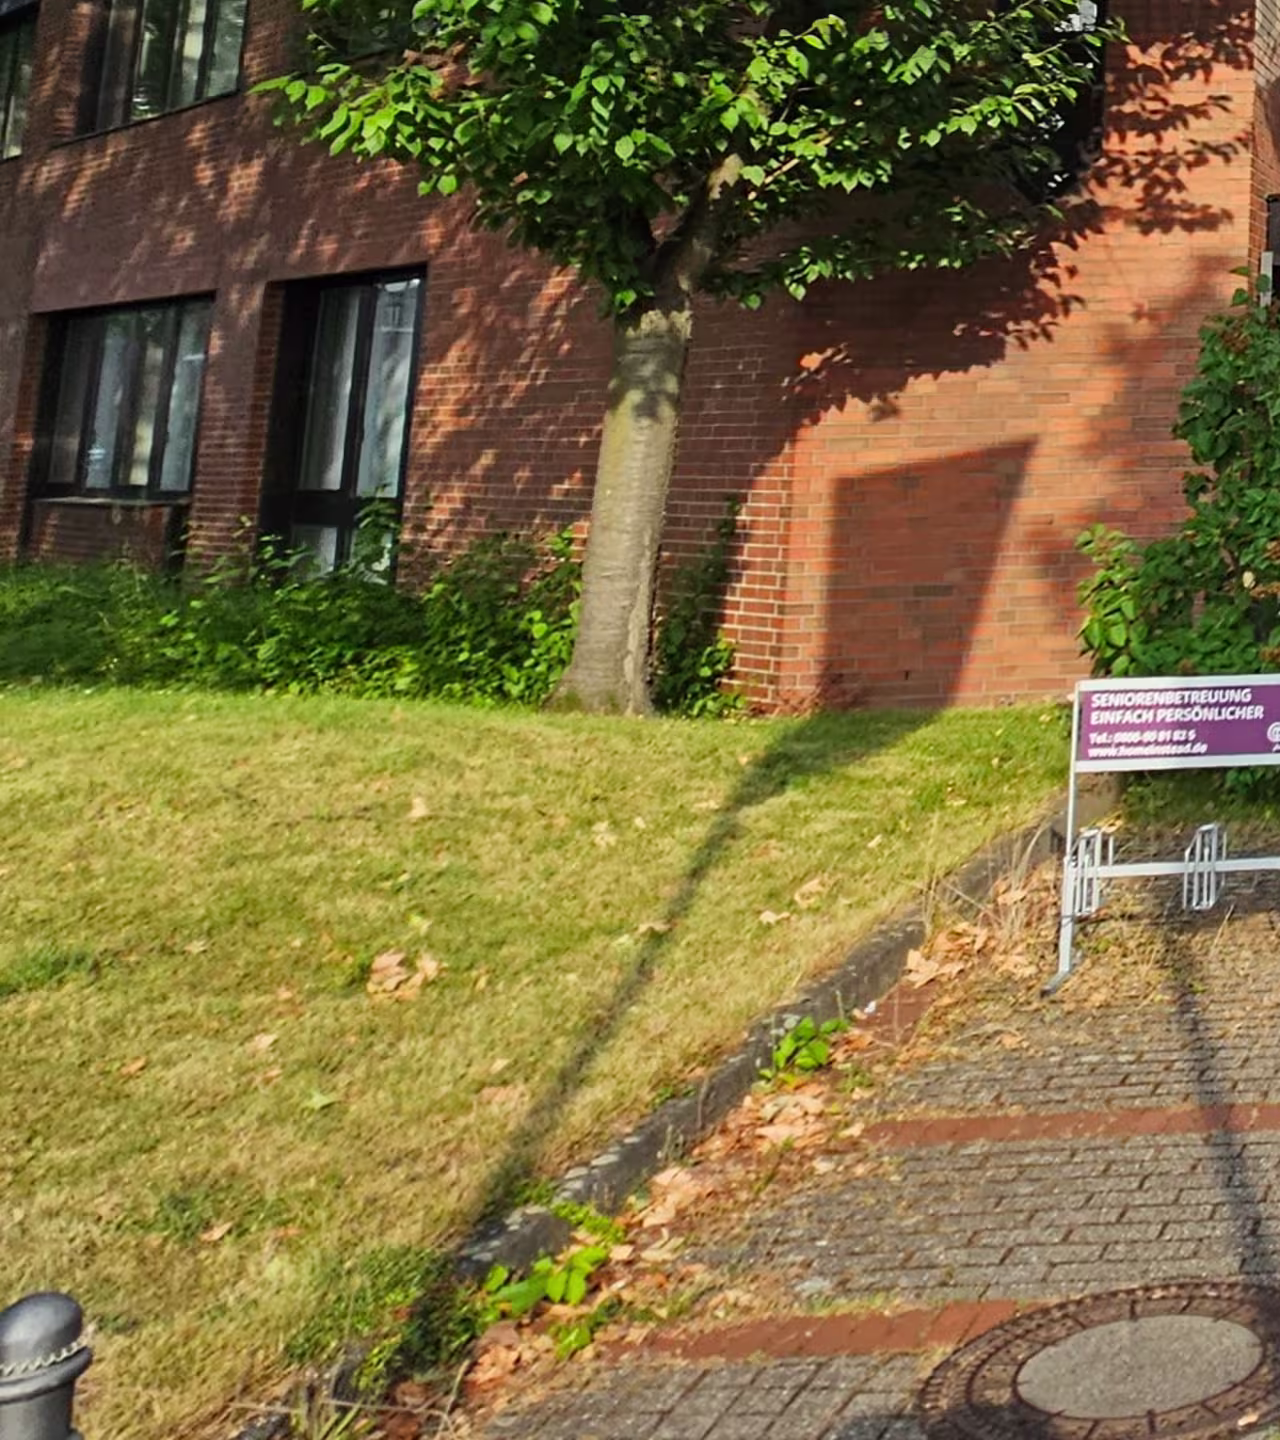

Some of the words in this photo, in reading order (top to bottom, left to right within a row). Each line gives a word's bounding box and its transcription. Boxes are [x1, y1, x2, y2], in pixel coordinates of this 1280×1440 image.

[1091, 688, 1252, 708] SENIORENBETREUUNG
[1091, 708, 1154, 725] EINFACH
[1156, 704, 1264, 723] PERSÖNLICHER
